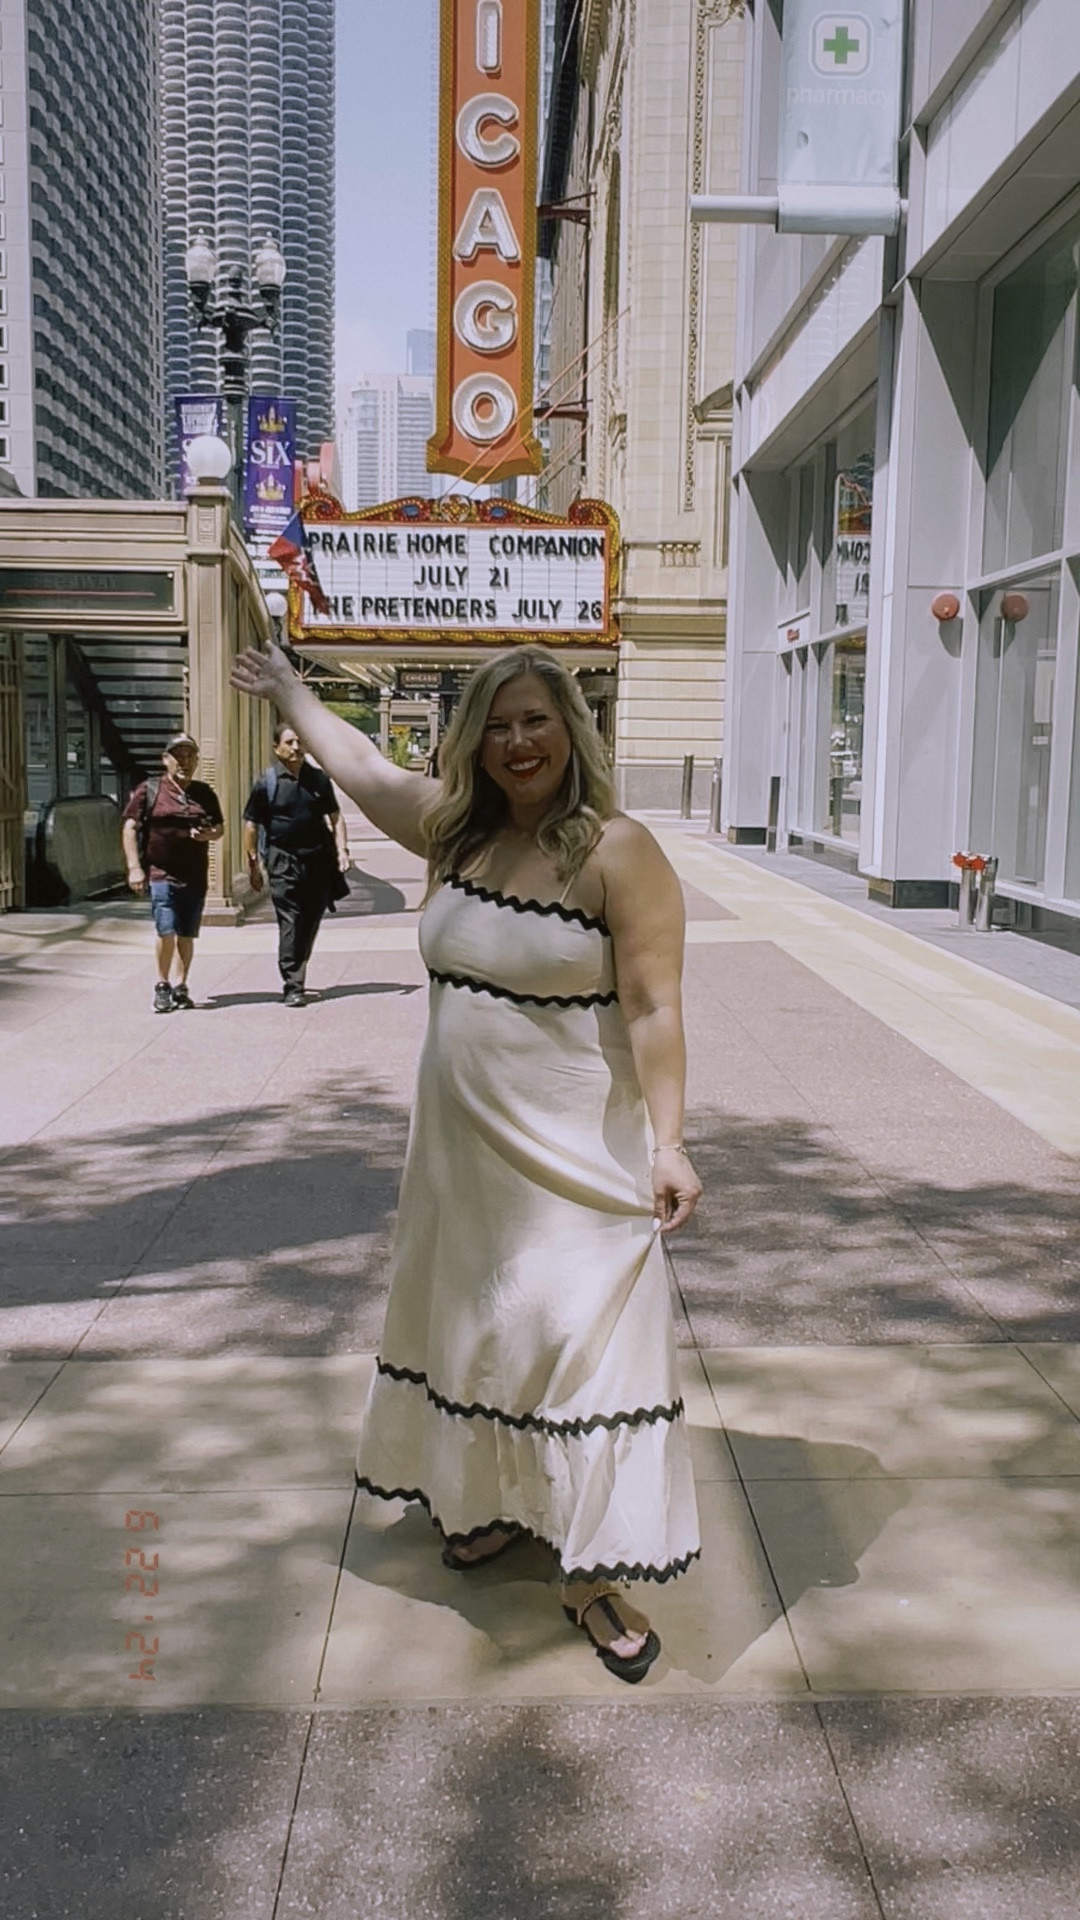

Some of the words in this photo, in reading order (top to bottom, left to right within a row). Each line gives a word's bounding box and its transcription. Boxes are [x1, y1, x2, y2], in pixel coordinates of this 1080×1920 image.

[250, 439, 291, 465] SIX
[308, 532, 397, 552] PRAIRIE
[407, 533, 466, 555] HOME
[489, 535, 605, 557] COMPANION
[414, 566, 468, 587] JULY
[489, 567, 510, 587] 21
[362, 597, 497, 619] PRETENDERS
[512, 599, 562, 621] JULY
[577, 601, 602, 620] 26
